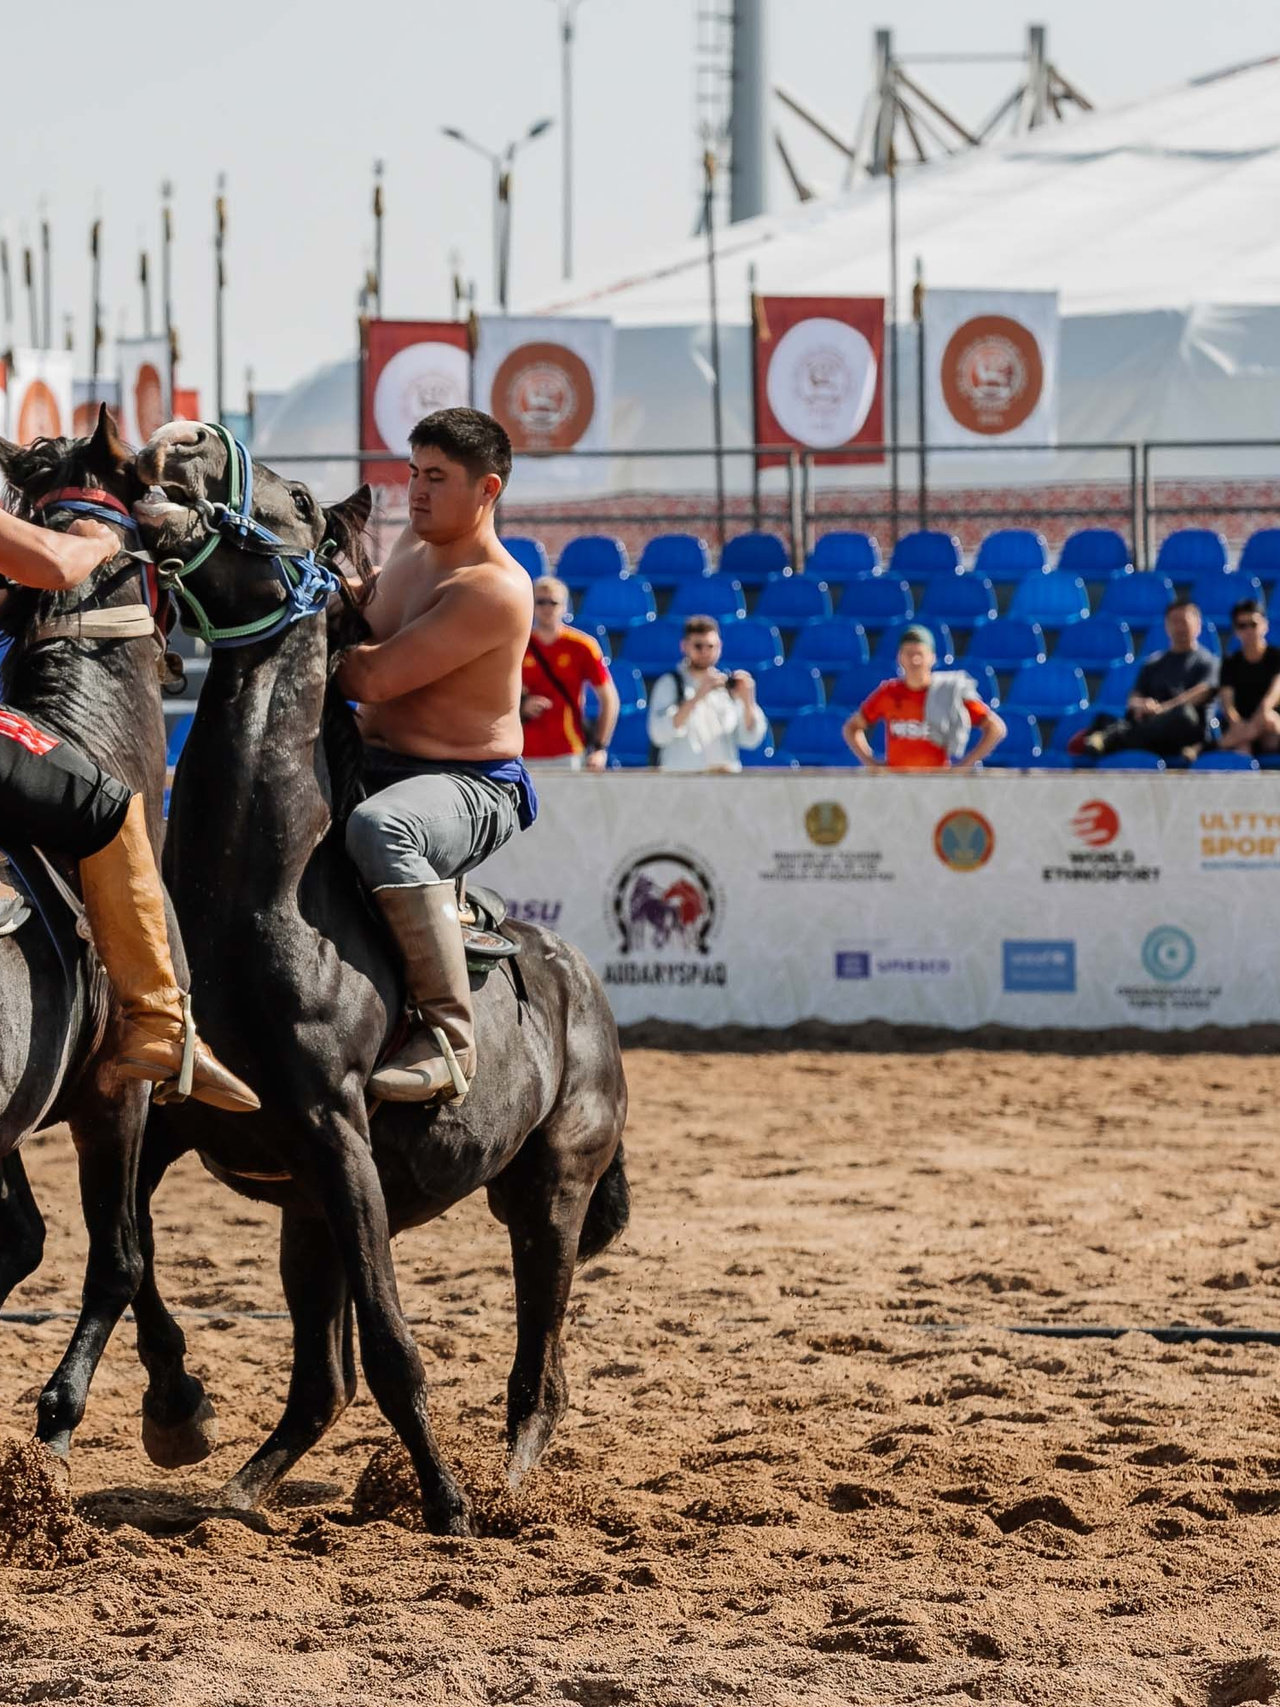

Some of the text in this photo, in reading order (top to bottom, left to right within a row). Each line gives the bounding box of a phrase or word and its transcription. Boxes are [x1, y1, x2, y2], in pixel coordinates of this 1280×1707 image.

[1069, 849, 1136, 864] WORLD
[1042, 865, 1160, 882] ETHNOSPORT
[877, 957, 951, 974] unesco
[604, 961, 727, 988] AUDARYSPAQ
